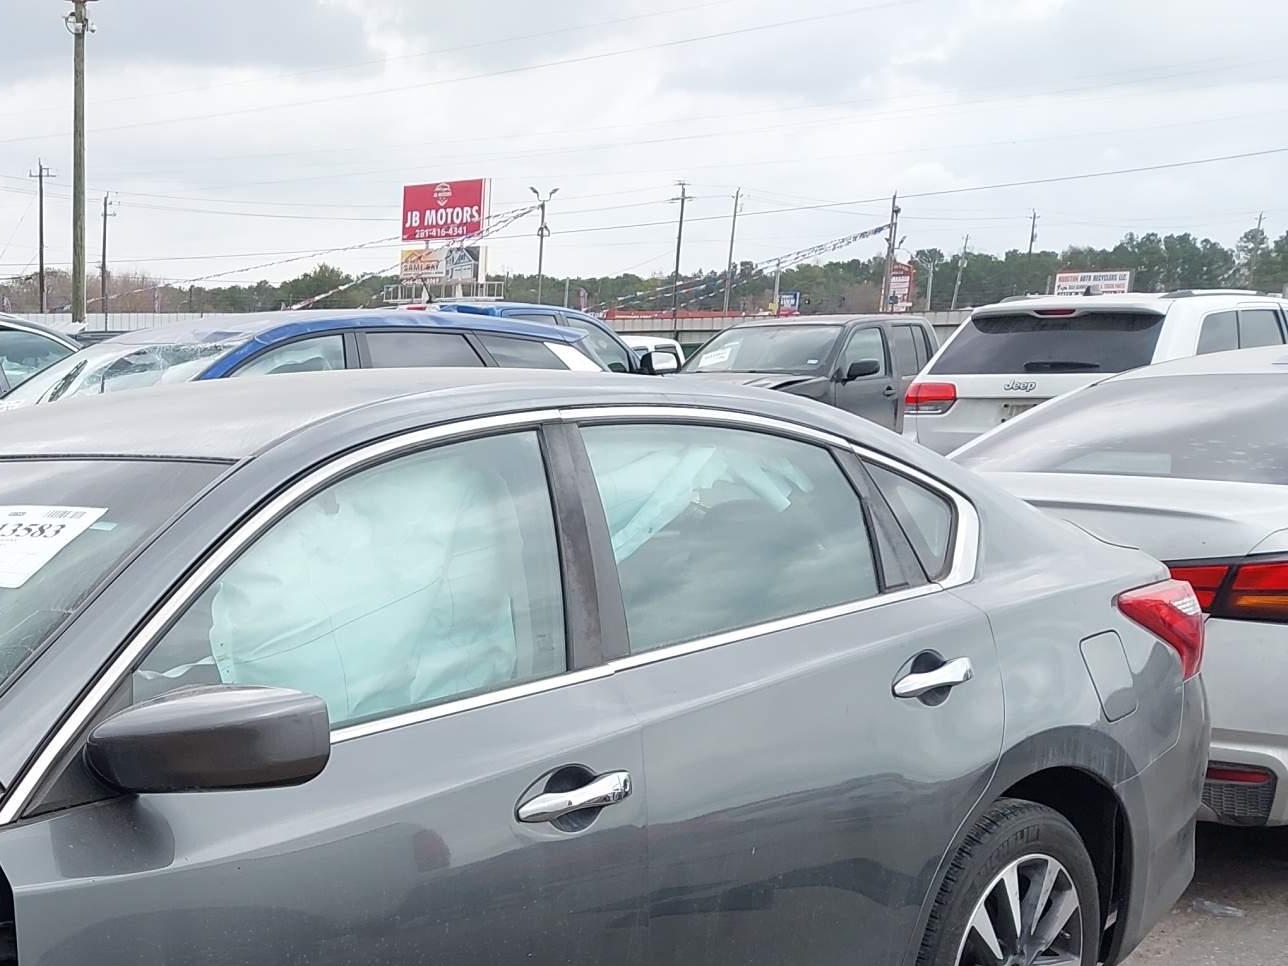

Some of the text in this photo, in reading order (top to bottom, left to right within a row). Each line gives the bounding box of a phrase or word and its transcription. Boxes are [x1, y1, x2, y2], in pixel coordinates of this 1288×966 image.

[405, 205, 479, 228] JB MOTORS
[415, 226, 467, 238] 281-416-4341
[1003, 379, 1036, 392] Jeep
